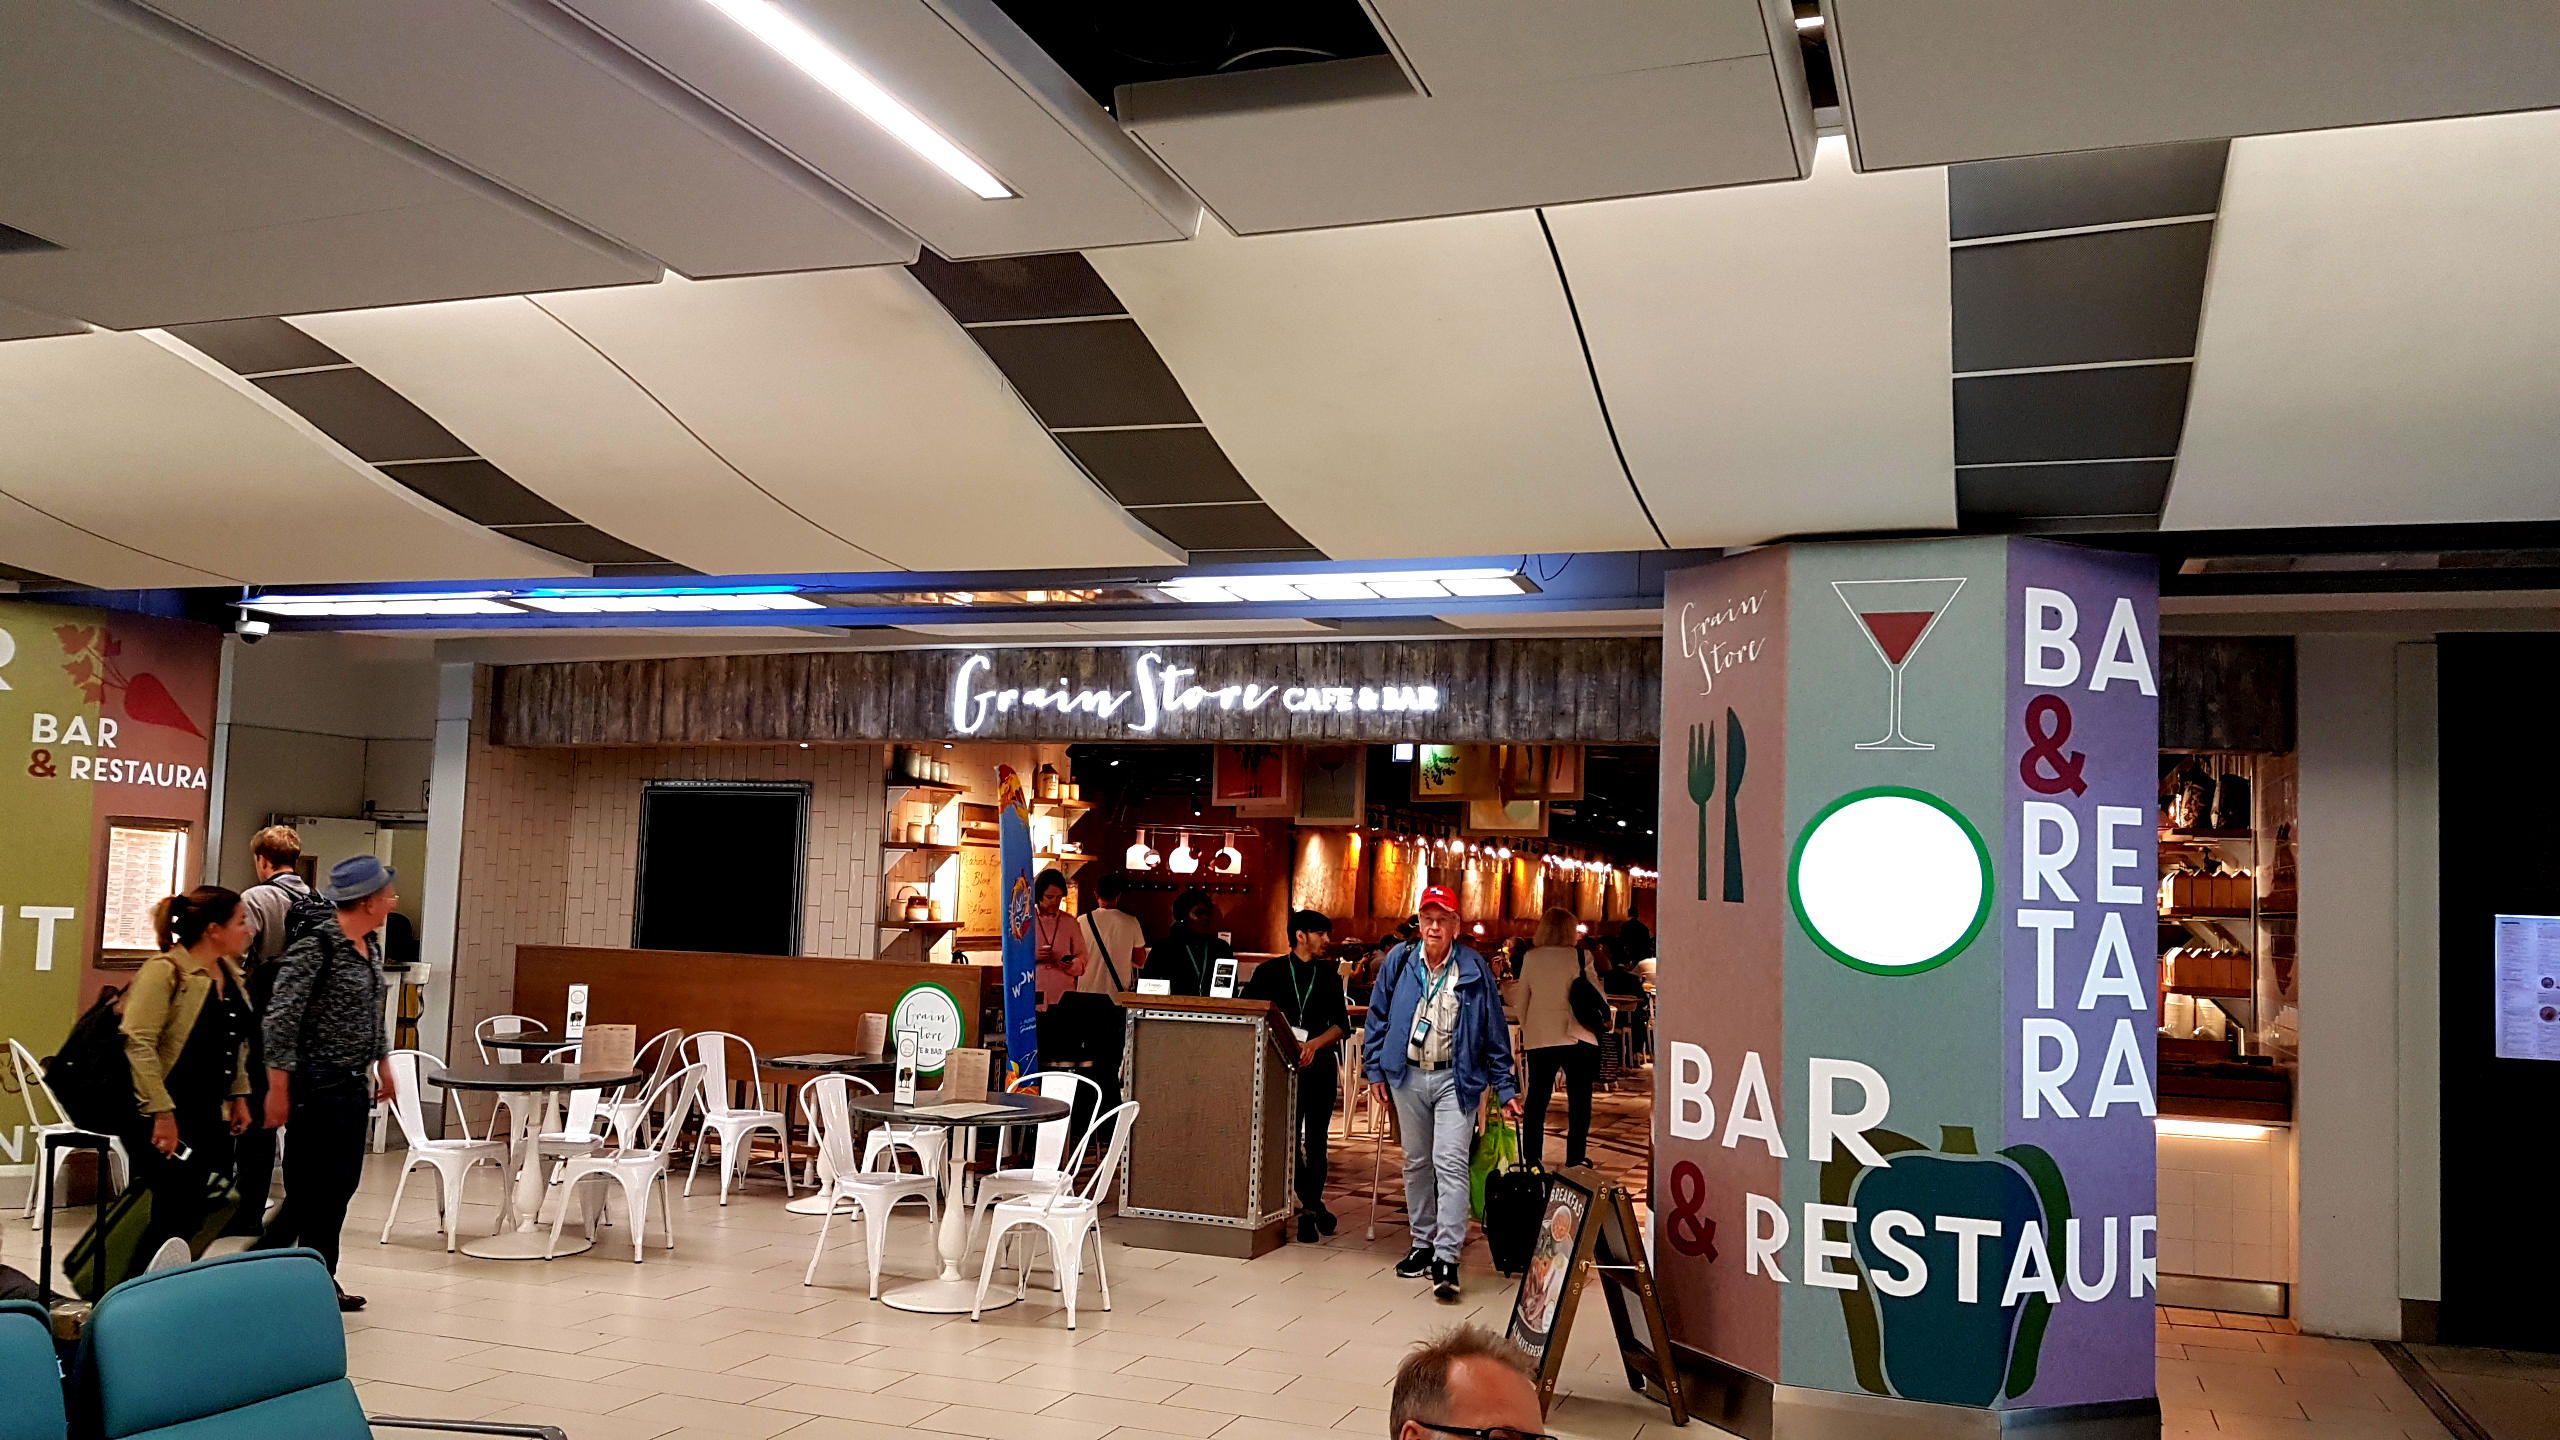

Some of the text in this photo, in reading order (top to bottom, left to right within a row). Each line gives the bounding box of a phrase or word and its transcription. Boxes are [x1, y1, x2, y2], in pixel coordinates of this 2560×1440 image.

[1681, 589, 1768, 659] Grain
[1698, 637, 1766, 696] Store
[32, 712, 118, 748] BAR
[953, 650, 1437, 735] Grain Store CAFE & BAR
[28, 748, 207, 790] & RESTAURA
[2019, 694, 2088, 798] &
[2022, 800, 2143, 905] RE
[2017, 908, 2148, 1011] TA
[1669, 1040, 1892, 1169] BAR
[2021, 1017, 2157, 1120] RA
[1666, 1159, 1719, 1265] &
